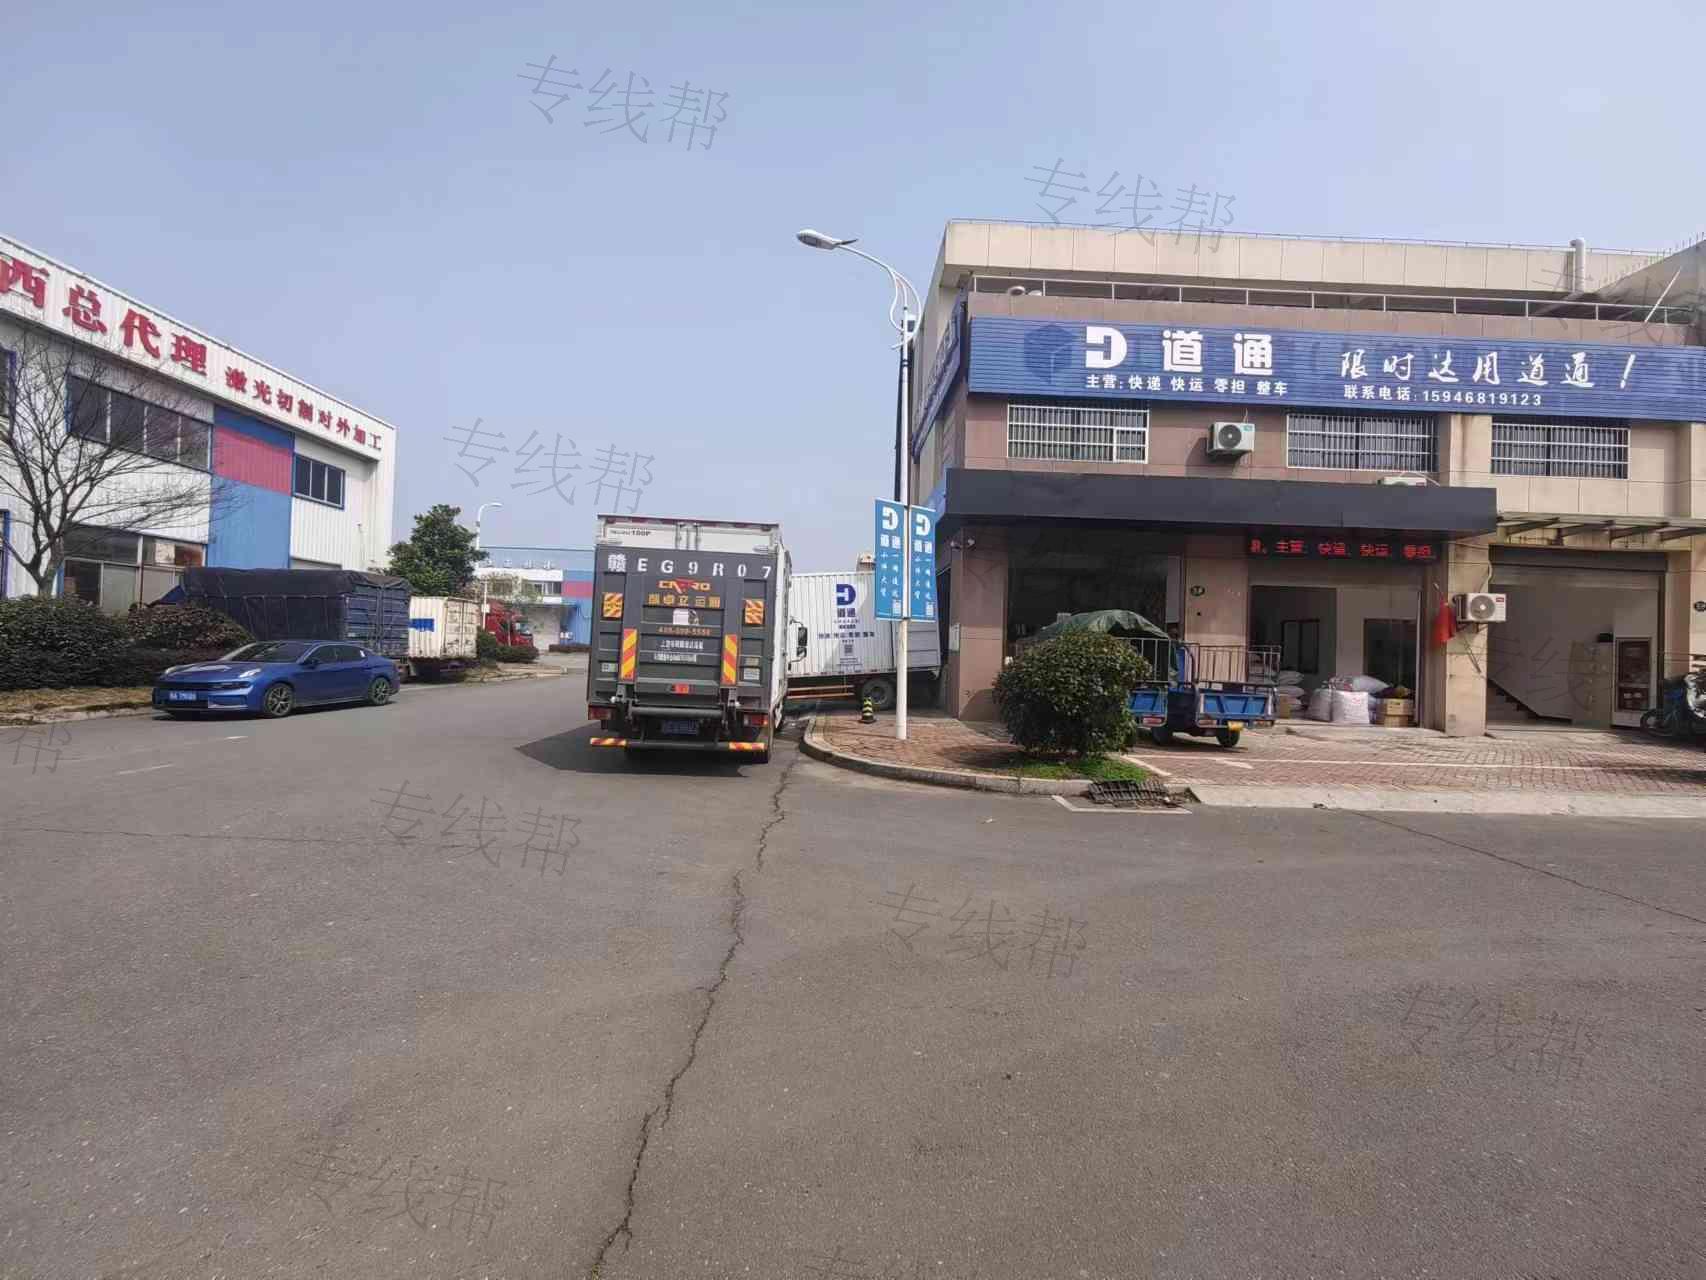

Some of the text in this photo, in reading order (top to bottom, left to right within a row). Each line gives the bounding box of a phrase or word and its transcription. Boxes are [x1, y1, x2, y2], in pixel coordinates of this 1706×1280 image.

[0, 257, 208, 377] 西总代理
[1162, 329, 1273, 376] 道通
[1171, 377, 1204, 392] 快运
[1214, 379, 1246, 394] 零担
[1256, 380, 1289, 396] 整车
